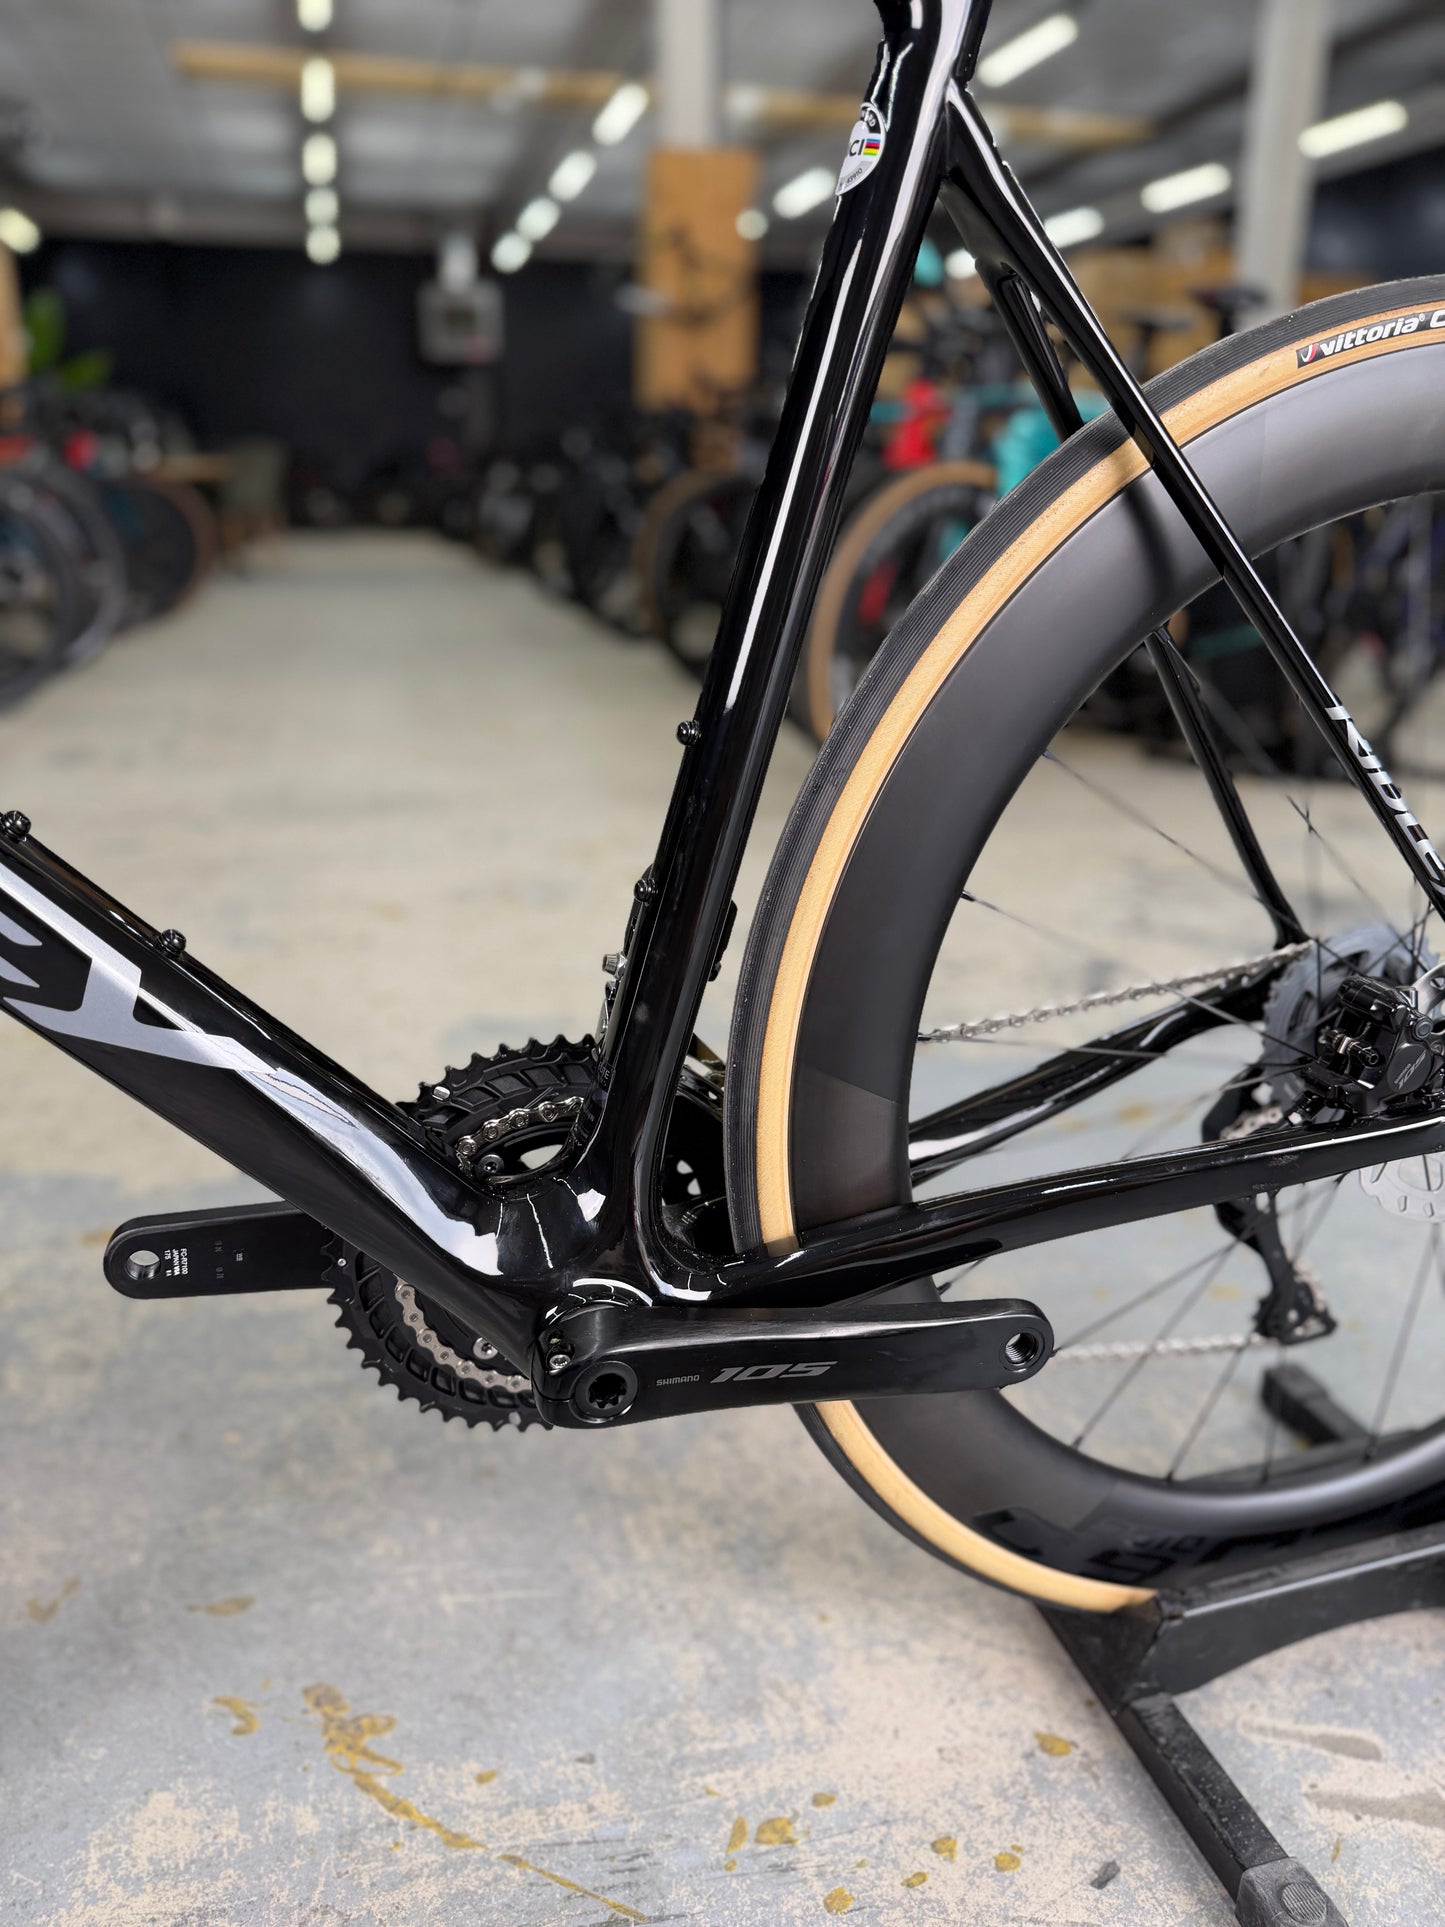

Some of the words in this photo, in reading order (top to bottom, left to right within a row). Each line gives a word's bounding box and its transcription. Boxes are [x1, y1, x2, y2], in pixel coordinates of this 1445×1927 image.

[849, 138, 865, 157] CI
[1324, 705, 1445, 896] RIDLE
[656, 1374, 700, 1386] SHIMANO
[710, 1361, 838, 1384] 105
